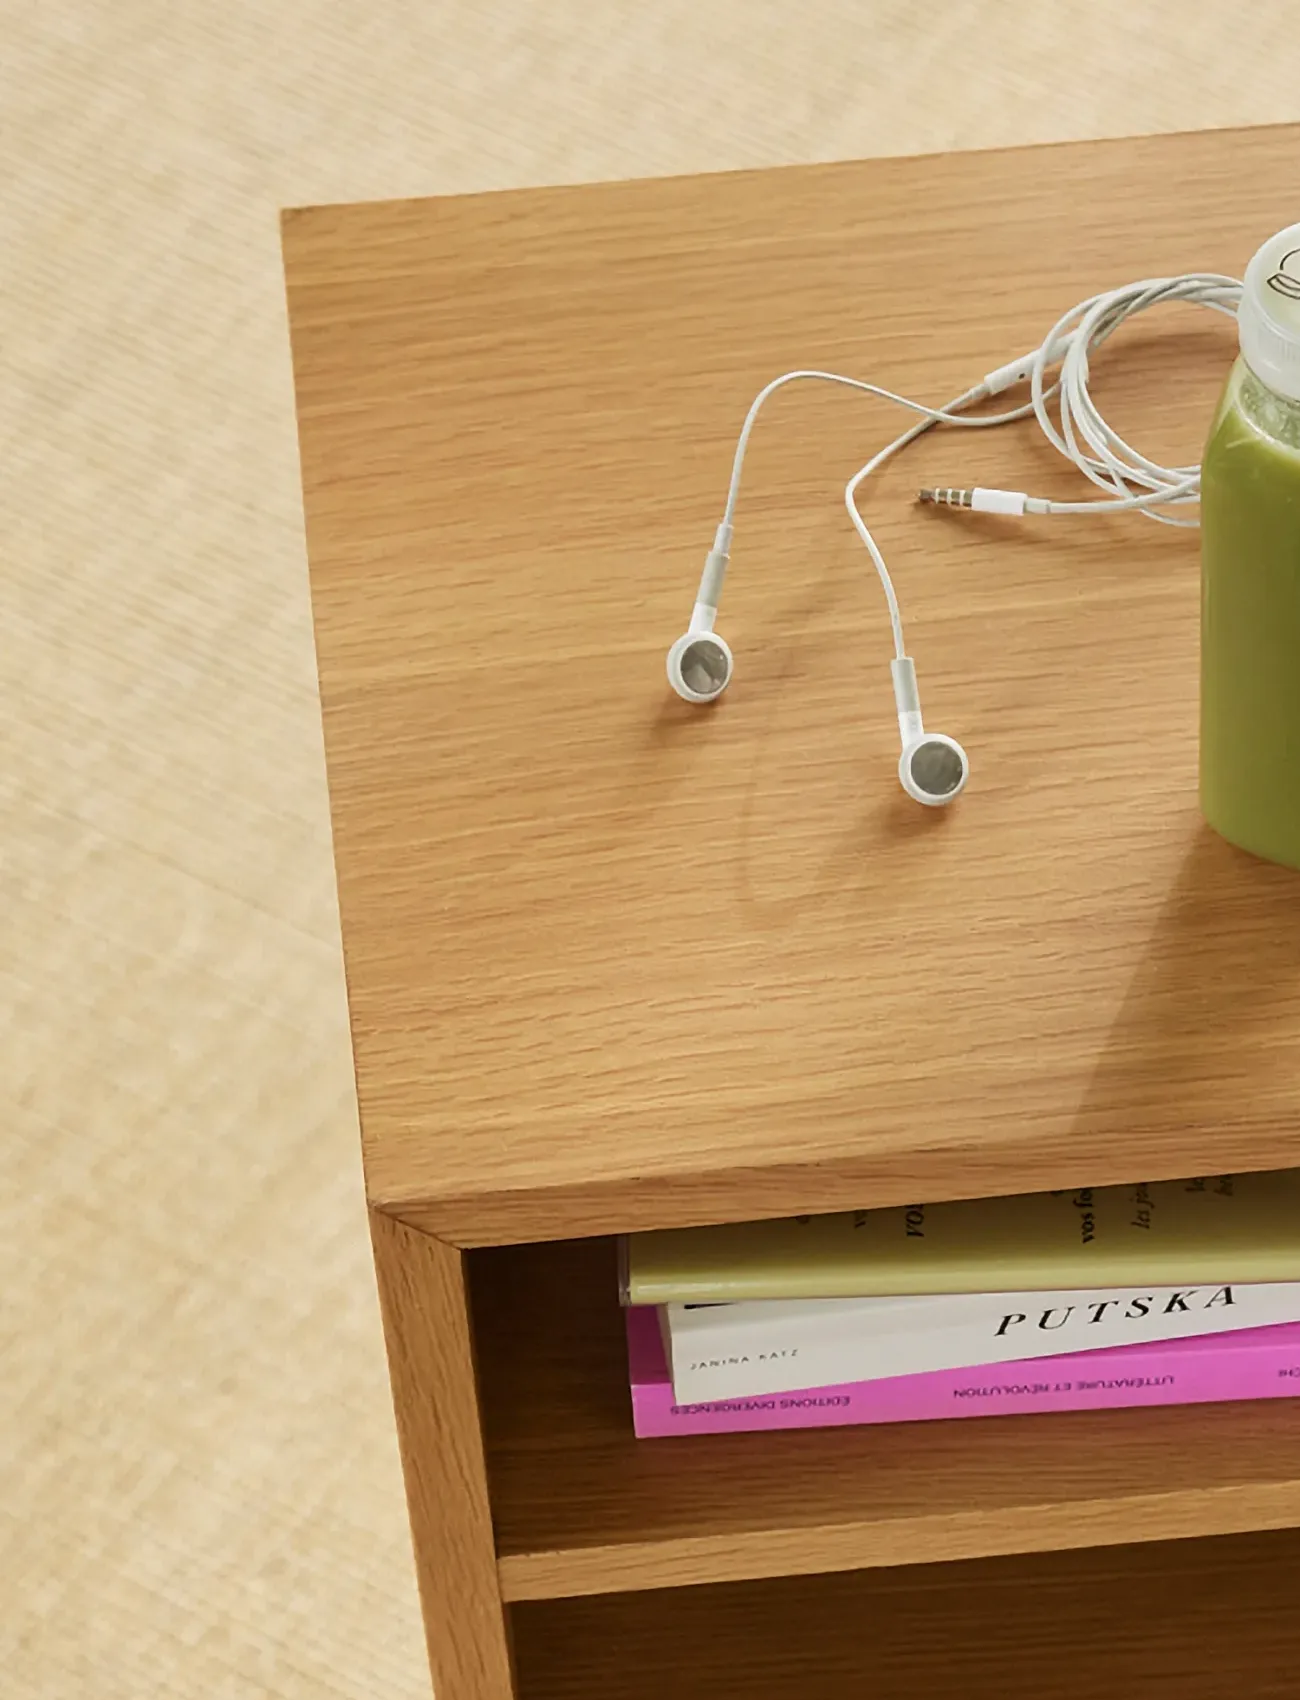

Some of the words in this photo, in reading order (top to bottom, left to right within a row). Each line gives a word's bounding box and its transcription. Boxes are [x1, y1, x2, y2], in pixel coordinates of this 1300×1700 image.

[1081, 1211, 1096, 1244] vos
[993, 1285, 1237, 1337] PUTSKA
[690, 1356, 750, 1371] JANINA
[759, 1348, 799, 1361] KATZ
[1054, 1380, 1072, 1392] ET
